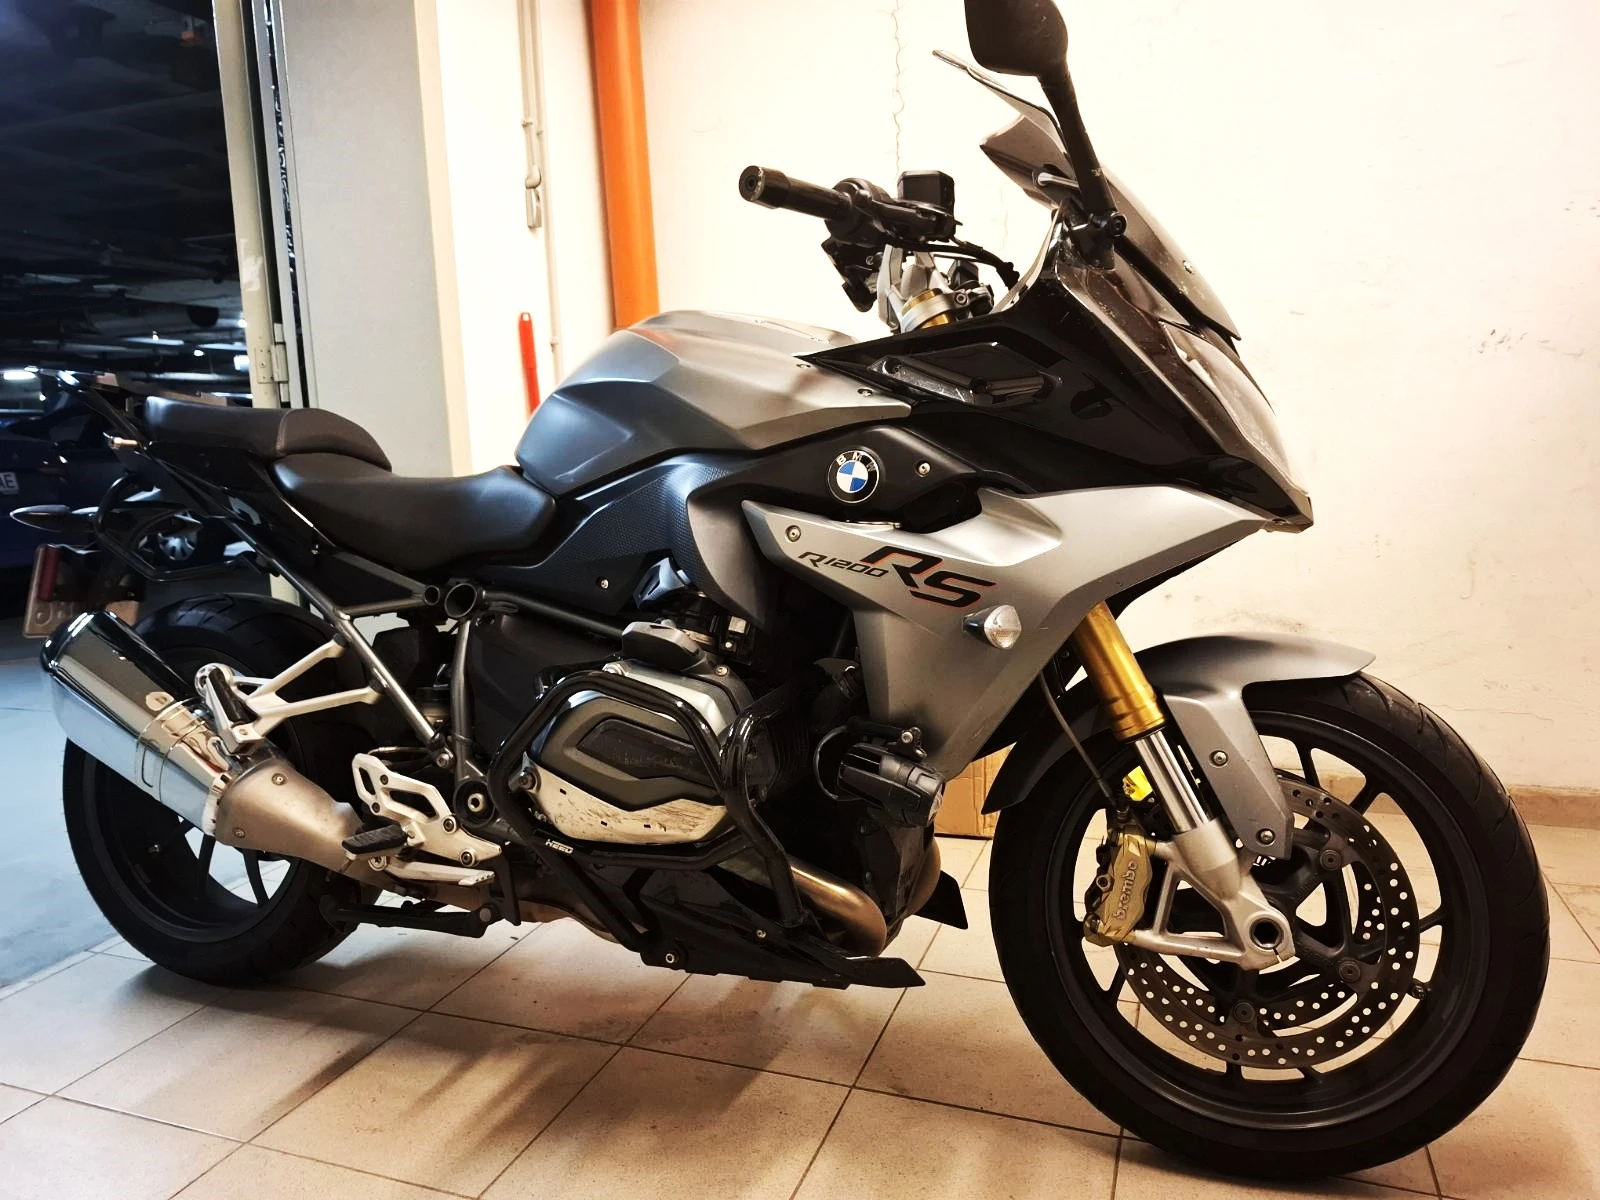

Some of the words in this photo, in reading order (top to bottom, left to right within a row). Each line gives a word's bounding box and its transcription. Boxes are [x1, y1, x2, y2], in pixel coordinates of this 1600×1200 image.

[836, 451, 878, 472] BMW
[798, 551, 889, 578] R1200
[859, 545, 998, 609] RS
[545, 838, 574, 854] HEED
[1113, 860, 1138, 919] brembo
